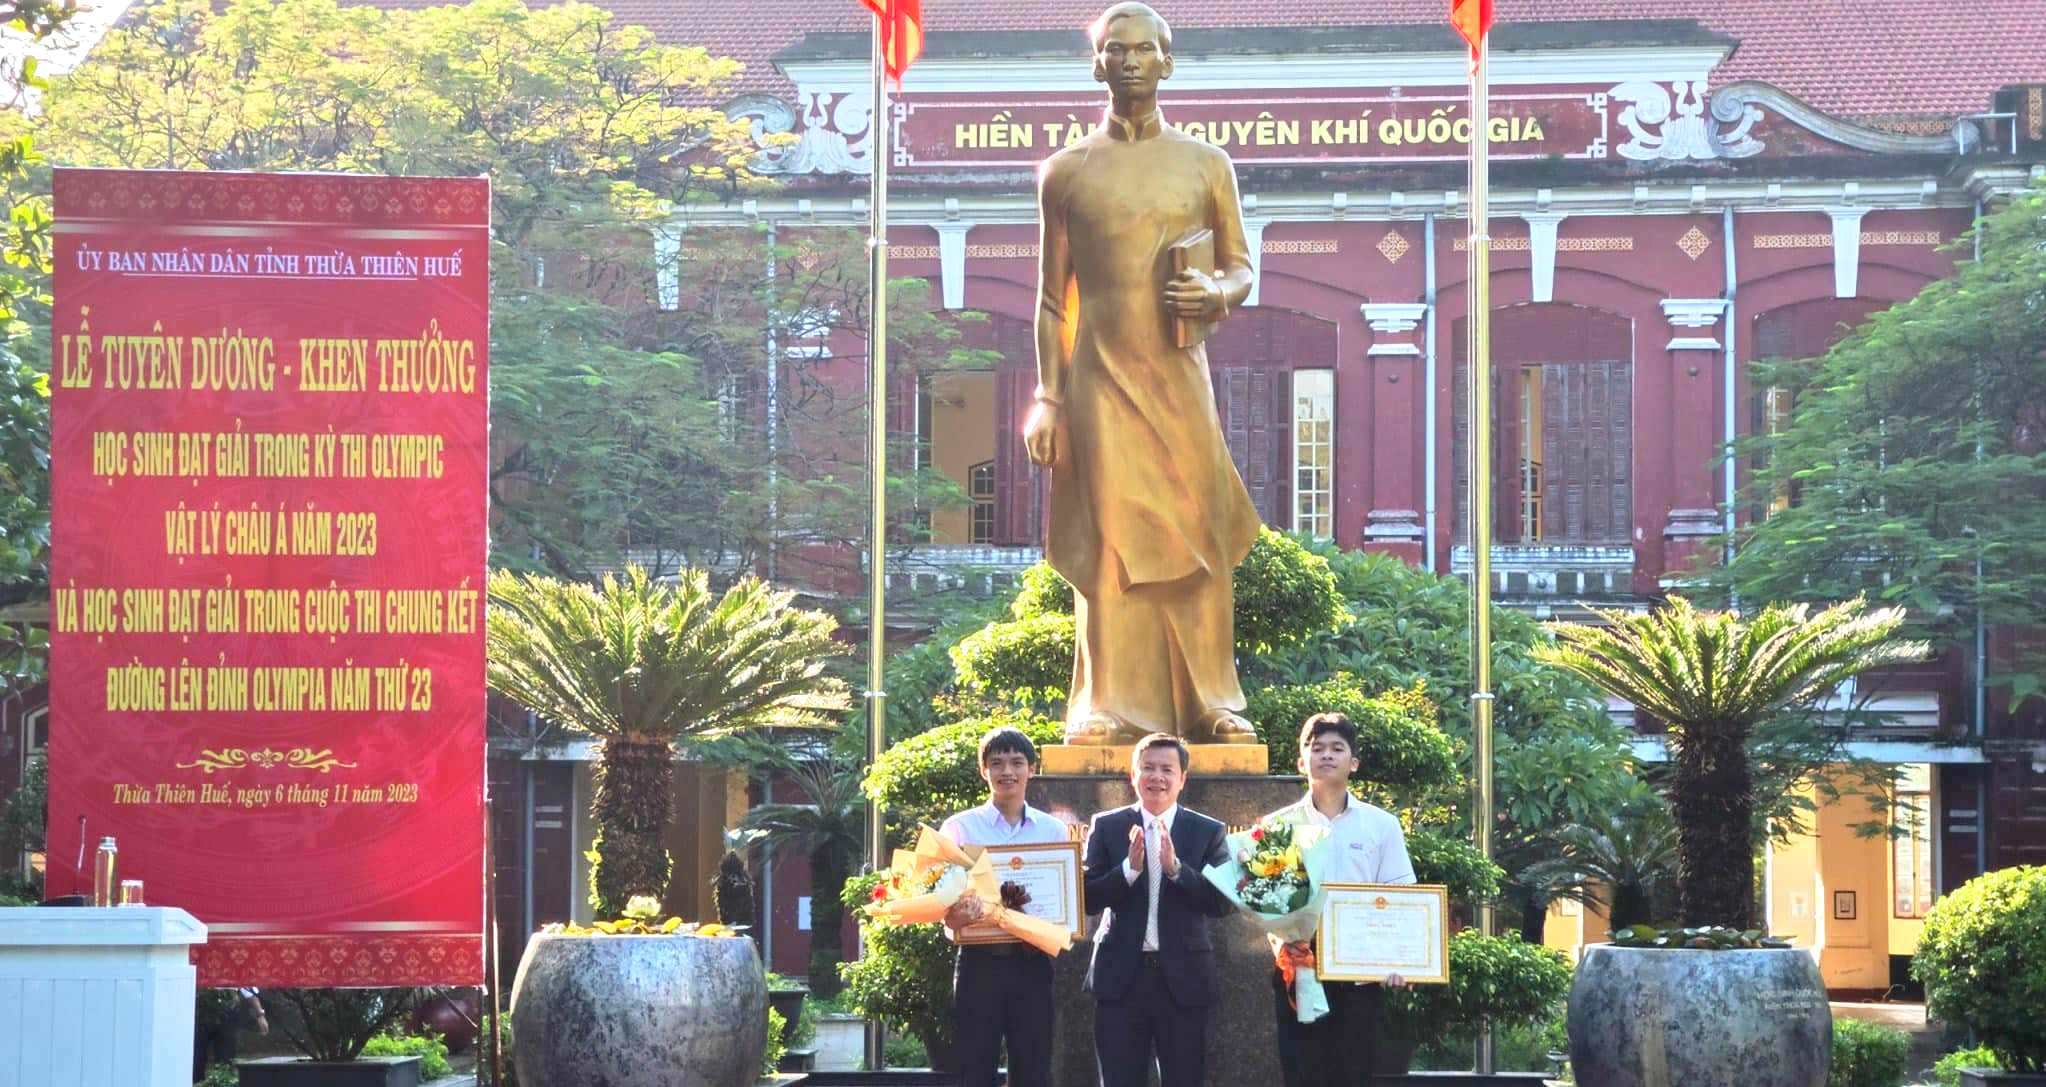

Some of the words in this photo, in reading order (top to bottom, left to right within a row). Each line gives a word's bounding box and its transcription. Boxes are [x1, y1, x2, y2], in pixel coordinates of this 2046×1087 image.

[955, 110, 1032, 148] HIỀN
[1175, 111, 1300, 146] GUYÊN
[1311, 110, 1371, 144] KHÍ
[1378, 105, 1473, 145] QUỐC
[1487, 116, 1544, 143] GIA
[77, 242, 103, 271] ỦY
[109, 251, 146, 271] BAN
[152, 247, 204, 272] NHÂN
[211, 248, 249, 273] DÂN
[254, 246, 299, 274] TỈNH
[305, 249, 356, 275] THỪA
[361, 251, 418, 276] THIÊN
[424, 248, 463, 276] HUẾ
[61, 305, 92, 388] LỄ
[101, 320, 183, 389] TUYÊN
[191, 327, 276, 391] DƯƠNG
[299, 339, 368, 392] KHEN
[376, 318, 476, 393] THƯỞNG
[93, 431, 127, 486] HỌC
[133, 432, 173, 477] SINH
[178, 433, 211, 486] ĐẠT
[216, 418, 249, 477] GIẢI
[254, 433, 309, 477] TRONG
[315, 424, 339, 477] KỲ
[341, 434, 366, 477] THI
[372, 434, 443, 478] OLYMPIC
[165, 502, 197, 564] VẬT
[201, 506, 222, 555] LÝ
[226, 502, 271, 555] CHÂU
[275, 506, 288, 555] Á
[292, 503, 332, 555] NĂM
[336, 513, 377, 556] 2023
[56, 579, 78, 633] VÀ
[83, 588, 117, 642] HỌC
[122, 589, 164, 633] SINH
[168, 589, 201, 642] ĐẠT
[206, 574, 239, 633] GIẢI
[244, 589, 300, 634] TRONG
[305, 580, 350, 643] CUỘC
[355, 590, 380, 633] THI
[385, 590, 442, 634] CHUNG
[447, 576, 478, 634] KẾT
[106, 658, 165, 711] ĐƯỜNG
[170, 659, 202, 711] LÊN
[207, 652, 248, 711] ĐỈNH
[253, 667, 326, 712] OLYMPIA
[331, 662, 370, 711] NĂM
[375, 658, 408, 711] THỨ
[411, 667, 432, 711] 23
[113, 783, 150, 803] Thừa
[154, 783, 195, 803] Thiên
[200, 780, 233, 807] Huế,
[237, 785, 271, 808] ngày
[275, 784, 284, 803] 6
[287, 784, 329, 808] tháng
[334, 784, 349, 803] 11
[352, 784, 383, 803] năm
[387, 783, 419, 803] 2023
